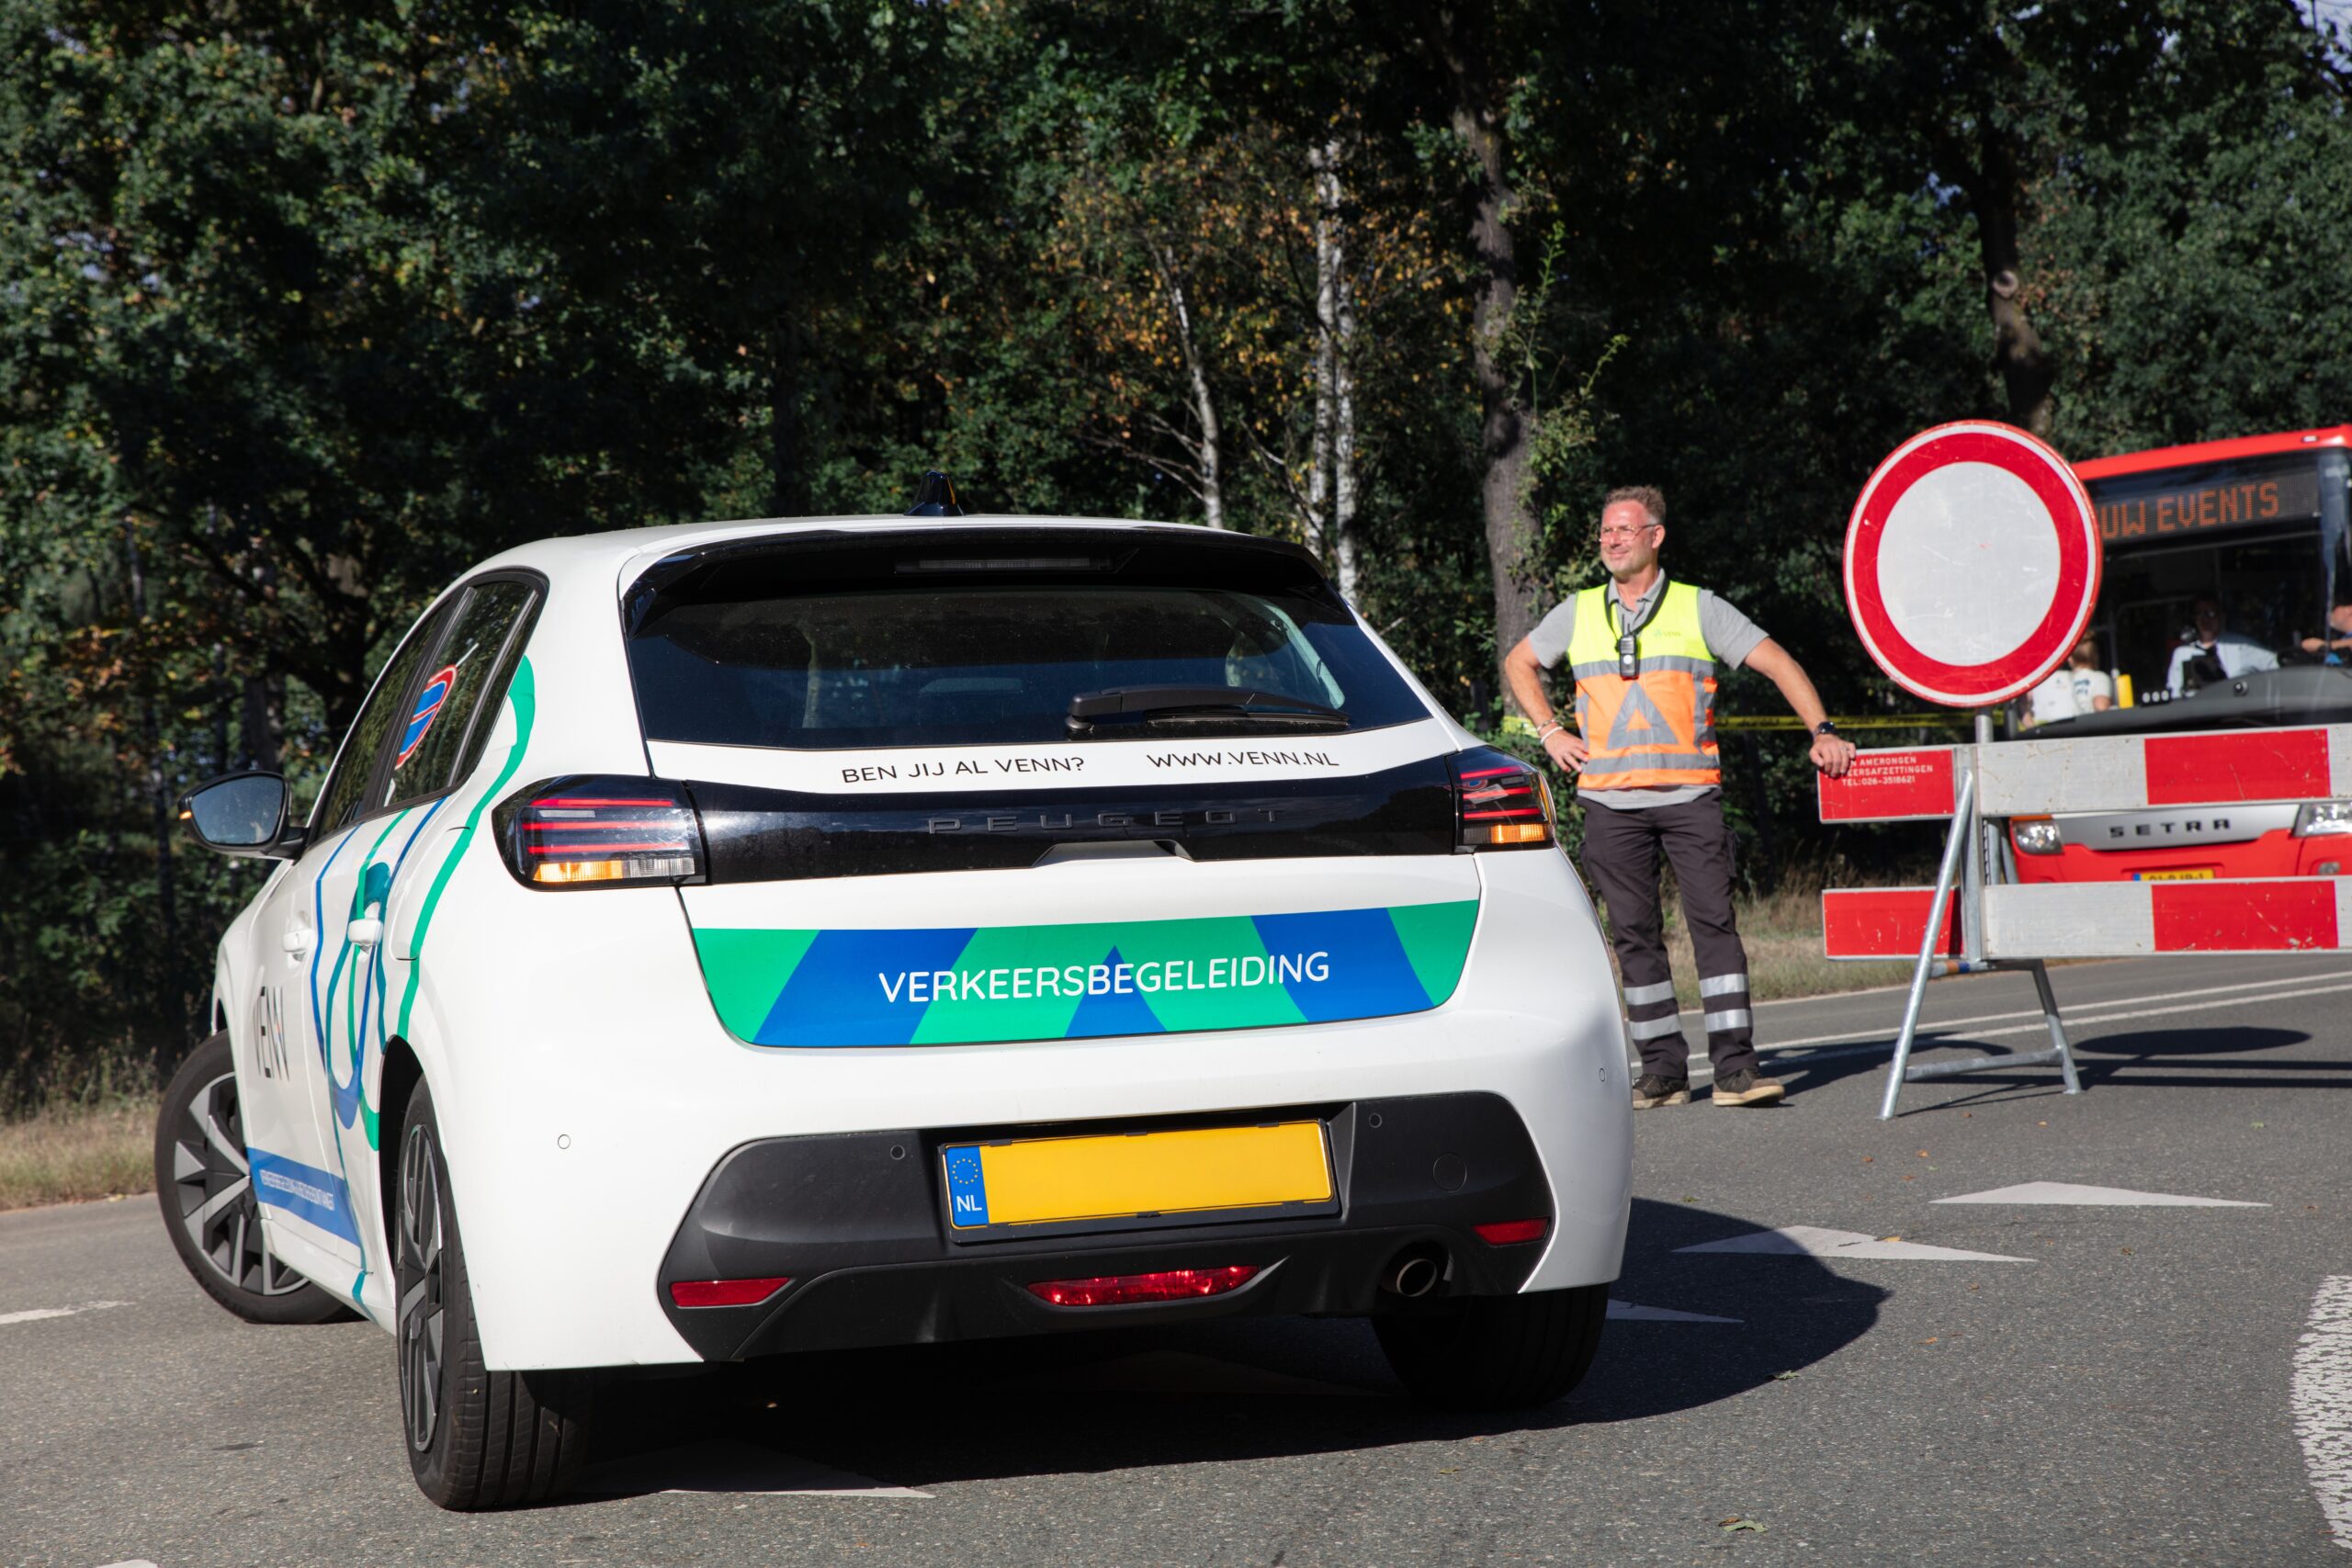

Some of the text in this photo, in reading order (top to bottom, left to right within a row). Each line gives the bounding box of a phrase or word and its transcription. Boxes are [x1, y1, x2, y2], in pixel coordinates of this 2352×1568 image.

[2155, 481, 2279, 533] EVENTS
[842, 757, 1085, 783] BEN JIJ AL VENN?
[1147, 751, 1340, 768] WWW.VENN.NL
[1859, 756, 1917, 767] AMERONGEN
[928, 808, 1285, 835] PEUGEOT
[2109, 818, 2231, 839] SETRA
[878, 951, 1329, 1003] VERKEERSBEGELEIDING
[956, 1194, 983, 1213] NL
